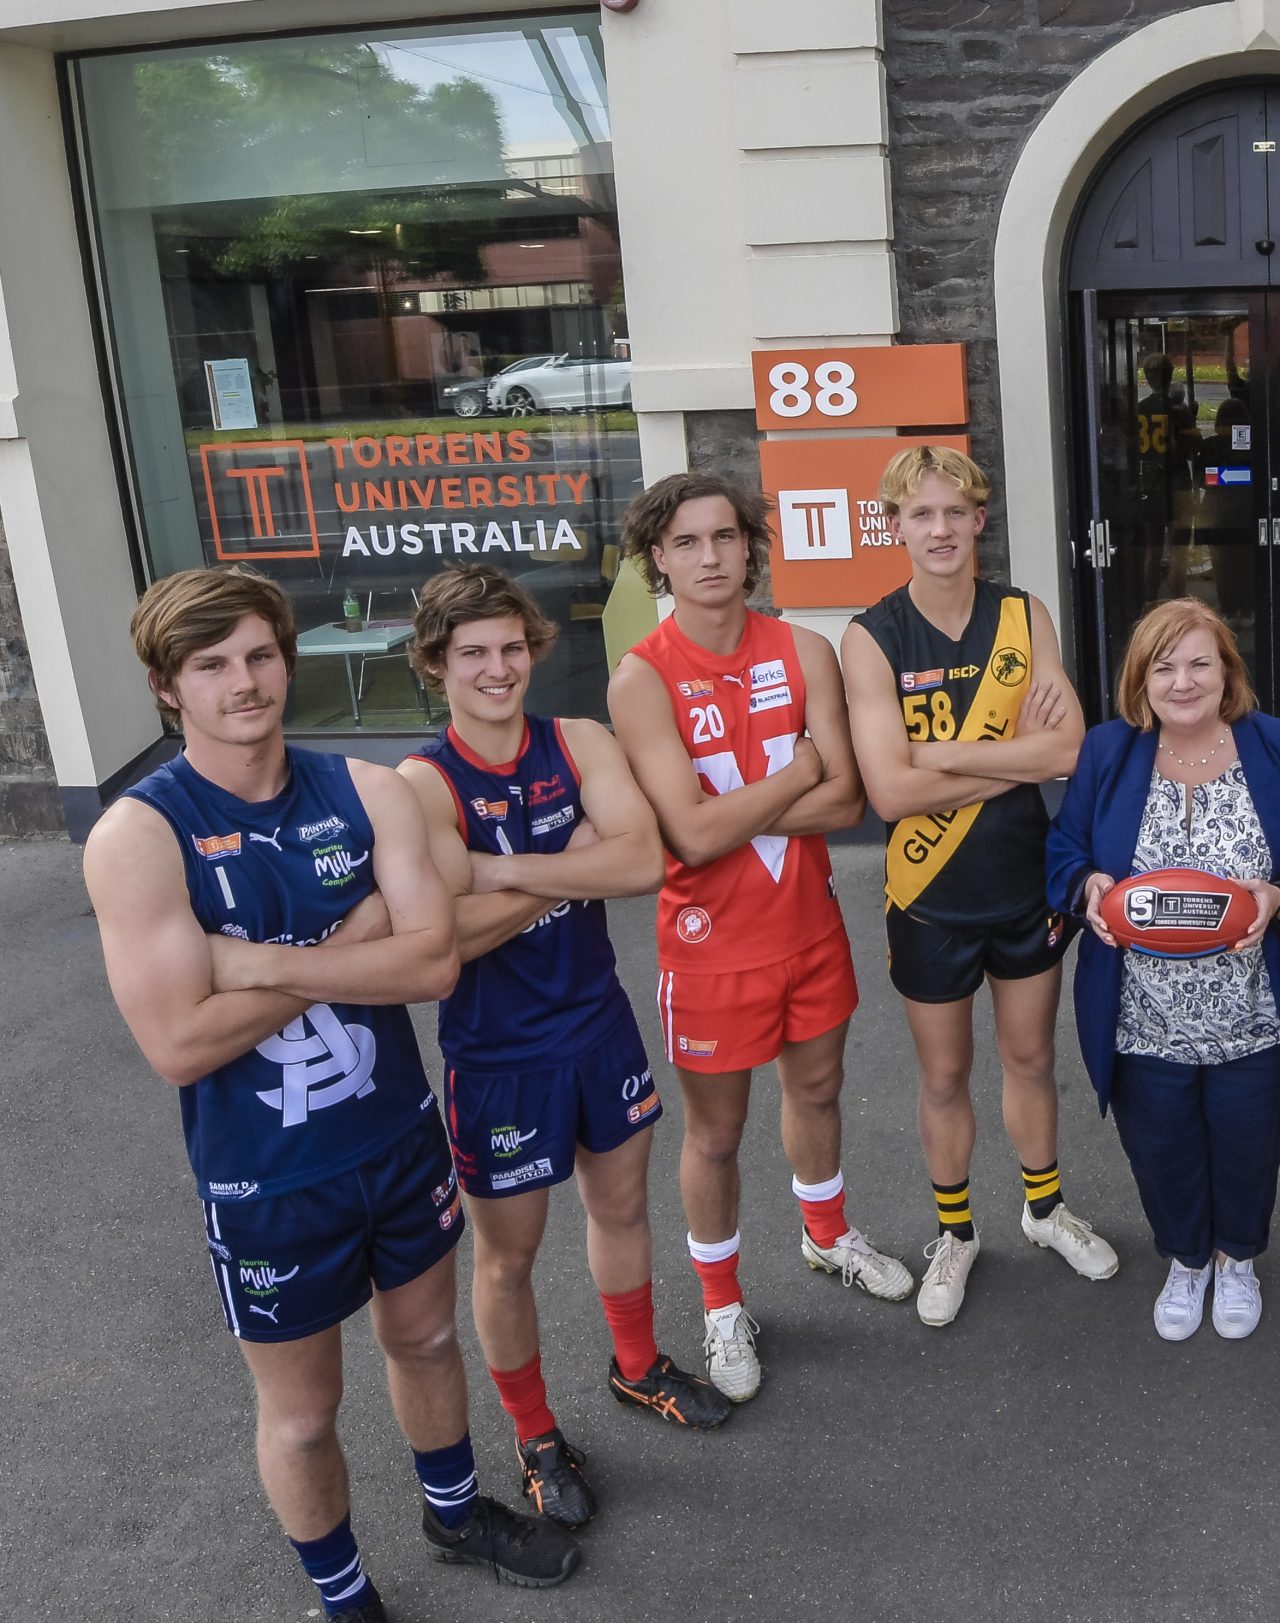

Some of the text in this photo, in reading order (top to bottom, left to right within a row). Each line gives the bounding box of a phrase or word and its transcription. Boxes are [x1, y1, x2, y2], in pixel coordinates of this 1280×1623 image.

[769, 361, 857, 417] 88
[327, 430, 532, 469] TORRENS
[335, 473, 589, 513] UNIVERSITY
[342, 519, 582, 557] AUSTRALIA
[689, 703, 725, 744] 20
[903, 690, 956, 741] 58
[315, 850, 369, 878] Milk
[215, 866, 236, 909] 1
[491, 1128, 538, 1152] Milk
[209, 1181, 249, 1191] SAMMY D
[492, 1163, 536, 1181] PARADISE
[515, 1168, 551, 1183] MAZDA
[240, 1265, 300, 1290] Milk
[244, 1286, 280, 1299] Company
